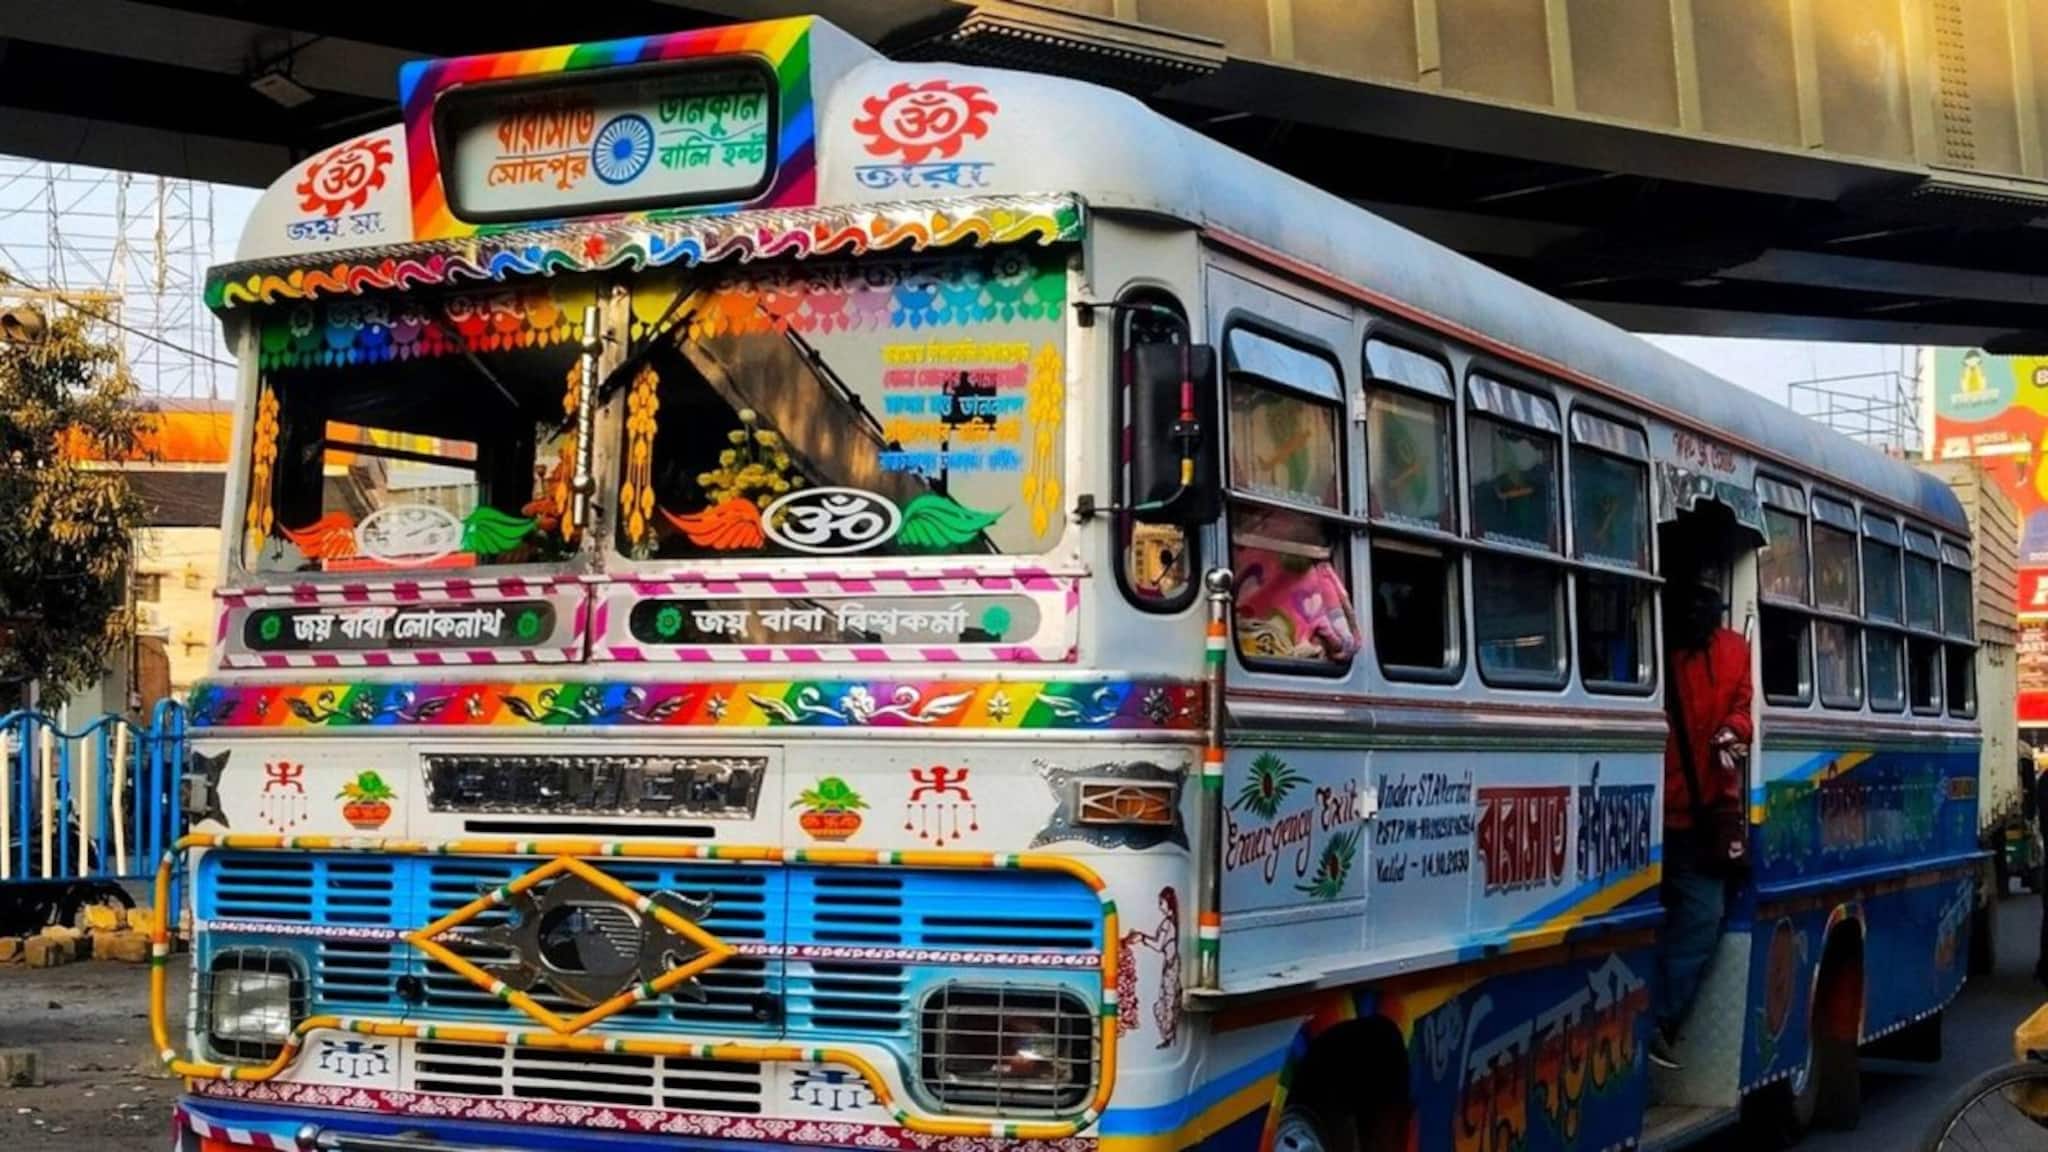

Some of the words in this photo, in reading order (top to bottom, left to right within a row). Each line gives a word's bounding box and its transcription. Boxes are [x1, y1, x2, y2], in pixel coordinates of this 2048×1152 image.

[658, 135, 714, 169] বালি
[487, 153, 590, 191] সোদপুর
[292, 613, 334, 642] জয়
[338, 607, 397, 640] বাবা
[392, 608, 505, 640] লোকনাথ
[692, 609, 751, 637] জয়
[756, 607, 826, 633] বাবা
[1377, 772, 1417, 810] Under
[1222, 806, 1314, 884] Emergency
